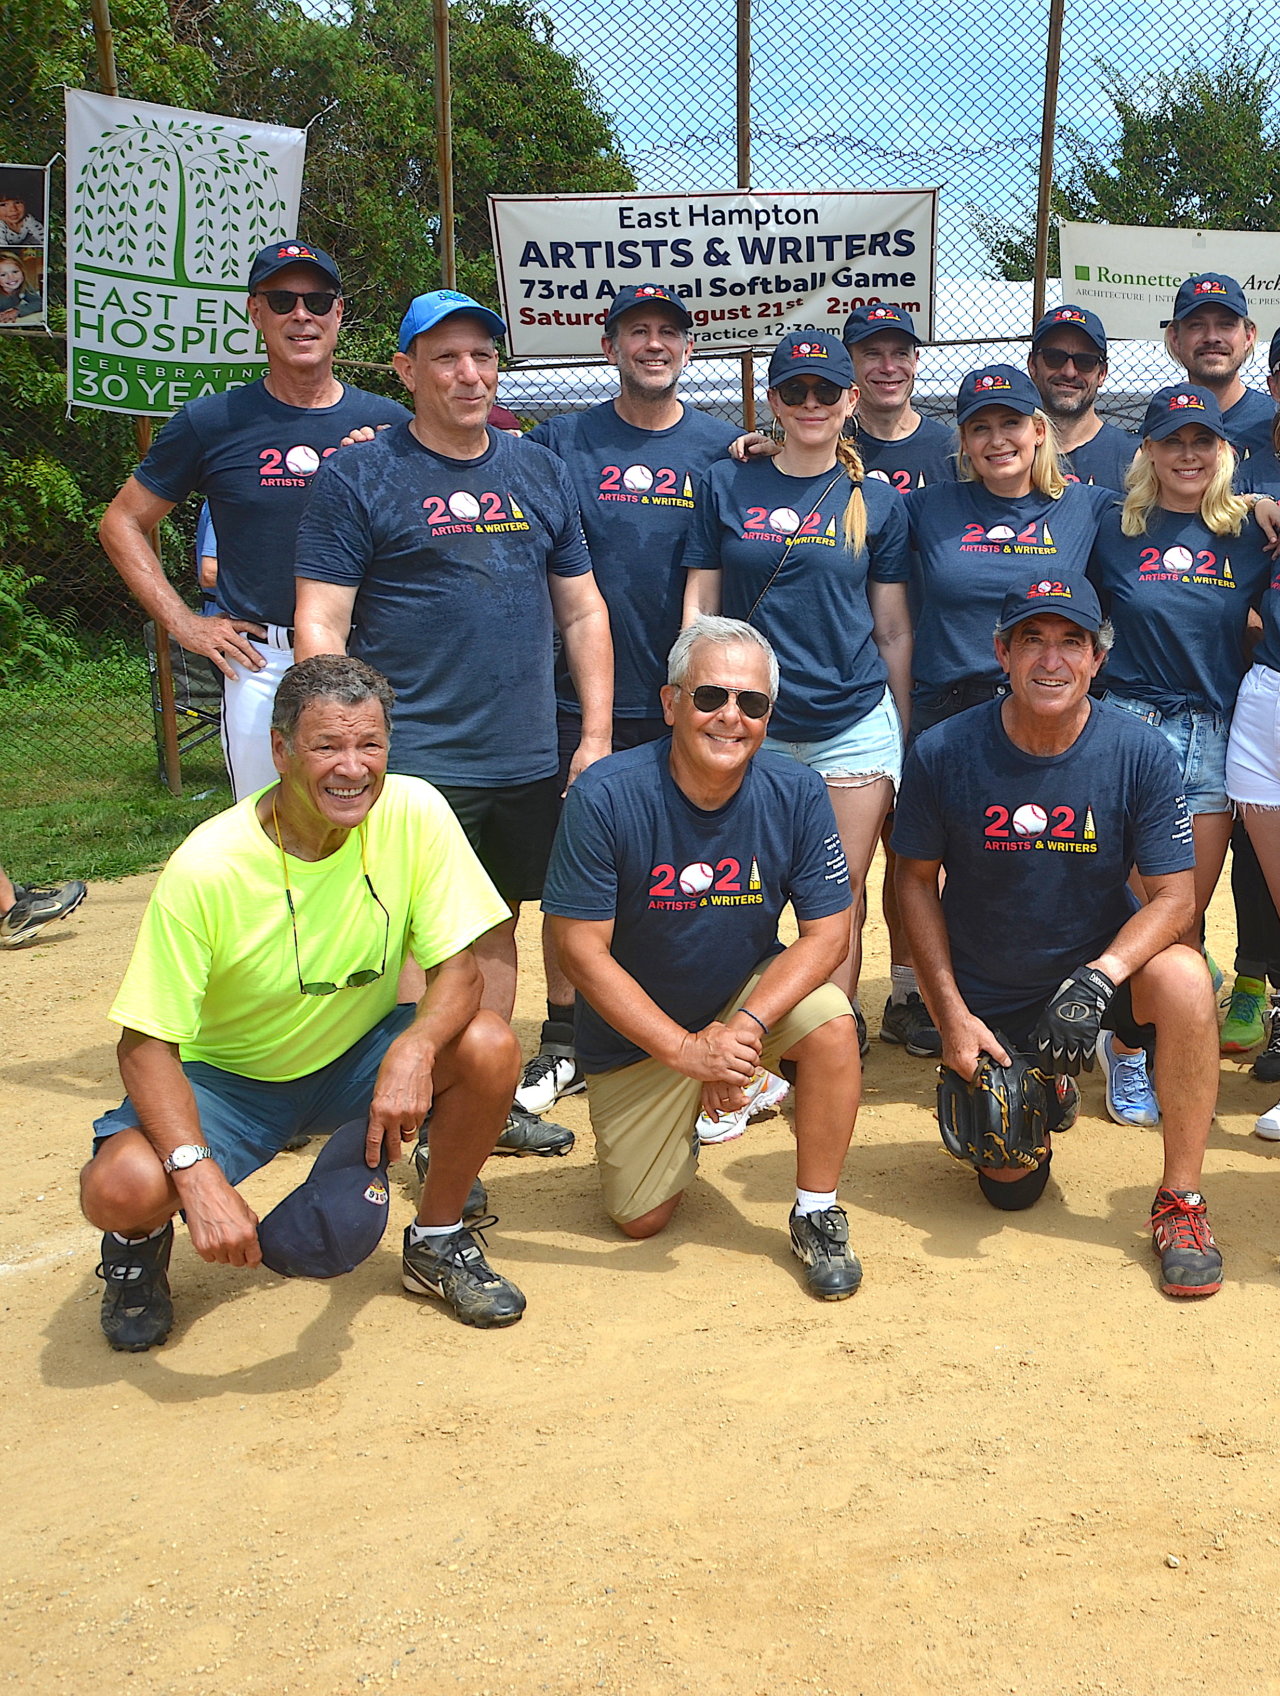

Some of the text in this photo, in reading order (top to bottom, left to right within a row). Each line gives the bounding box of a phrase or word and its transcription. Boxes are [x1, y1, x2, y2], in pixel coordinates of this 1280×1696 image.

[618, 204, 819, 231] East Hampton
[519, 228, 916, 269] ARTISTS & WRITERS
[519, 278, 588, 300] 73rd
[708, 272, 826, 298] Softball
[831, 266, 916, 288] Game
[1097, 265, 1182, 288] Ronnette
[73, 278, 178, 321] EAST
[1075, 288, 1145, 302] ARCHITECTURE
[757, 298, 804, 319] 21st
[74, 309, 269, 355] HOSPICE
[78, 355, 271, 379] CELEBRATING
[76, 368, 129, 402] 30
[259, 478, 306, 487] ARTISTS
[598, 493, 695, 509] ARTISTS & WRITERS
[431, 521, 530, 537] ARTISTS & WRITERS
[741, 531, 836, 548] ARTISTS & WRITERS
[959, 543, 1058, 555] ARTISTS & WRITERS
[1138, 573, 1237, 590] ARTISTS & WRITERS
[984, 840, 1098, 853] ARTISTS & WRITERS
[647, 893, 764, 911] ARTISTS & WRITERS
